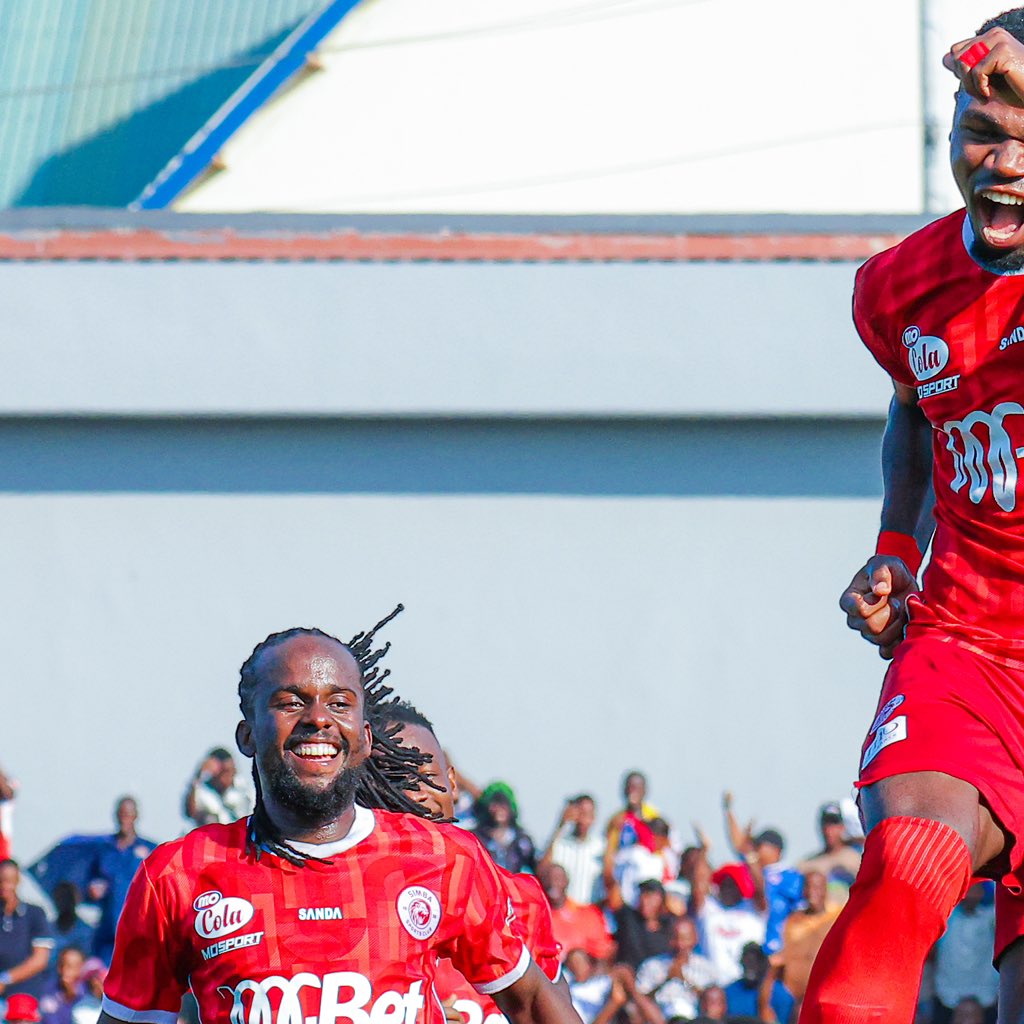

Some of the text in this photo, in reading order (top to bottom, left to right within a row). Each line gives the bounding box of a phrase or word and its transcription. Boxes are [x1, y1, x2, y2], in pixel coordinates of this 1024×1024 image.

[408, 889, 432, 902] SIMBA
[202, 904, 243, 935] Cola
[298, 907, 343, 921] SANDA
[201, 932, 264, 960] MOSPORT
